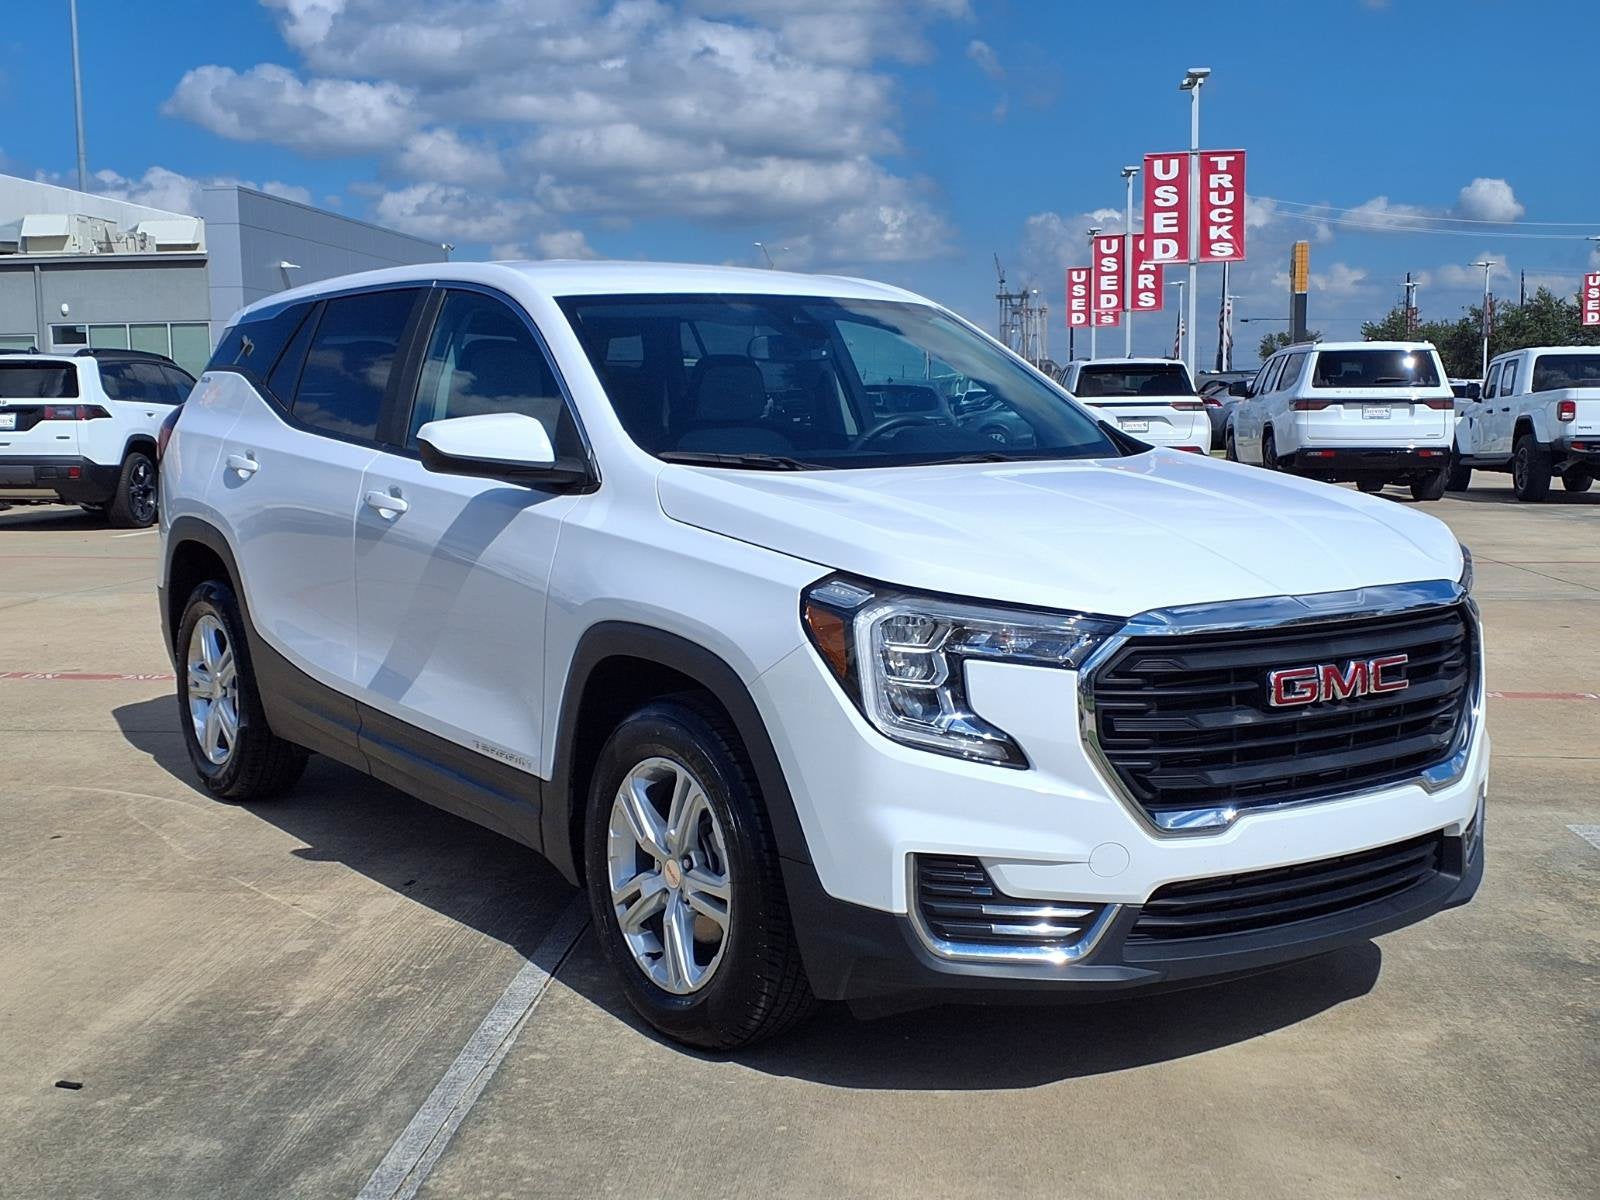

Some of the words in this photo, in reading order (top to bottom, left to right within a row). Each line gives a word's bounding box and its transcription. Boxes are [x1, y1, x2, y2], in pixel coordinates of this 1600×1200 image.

[1153, 159, 1179, 259] USED
[1209, 156, 1235, 257] TRUCKS
[1071, 270, 1086, 324] USED
[1100, 239, 1118, 309] USED
[1587, 275, 1600, 322] USED
[1268, 654, 1410, 707] GMC
